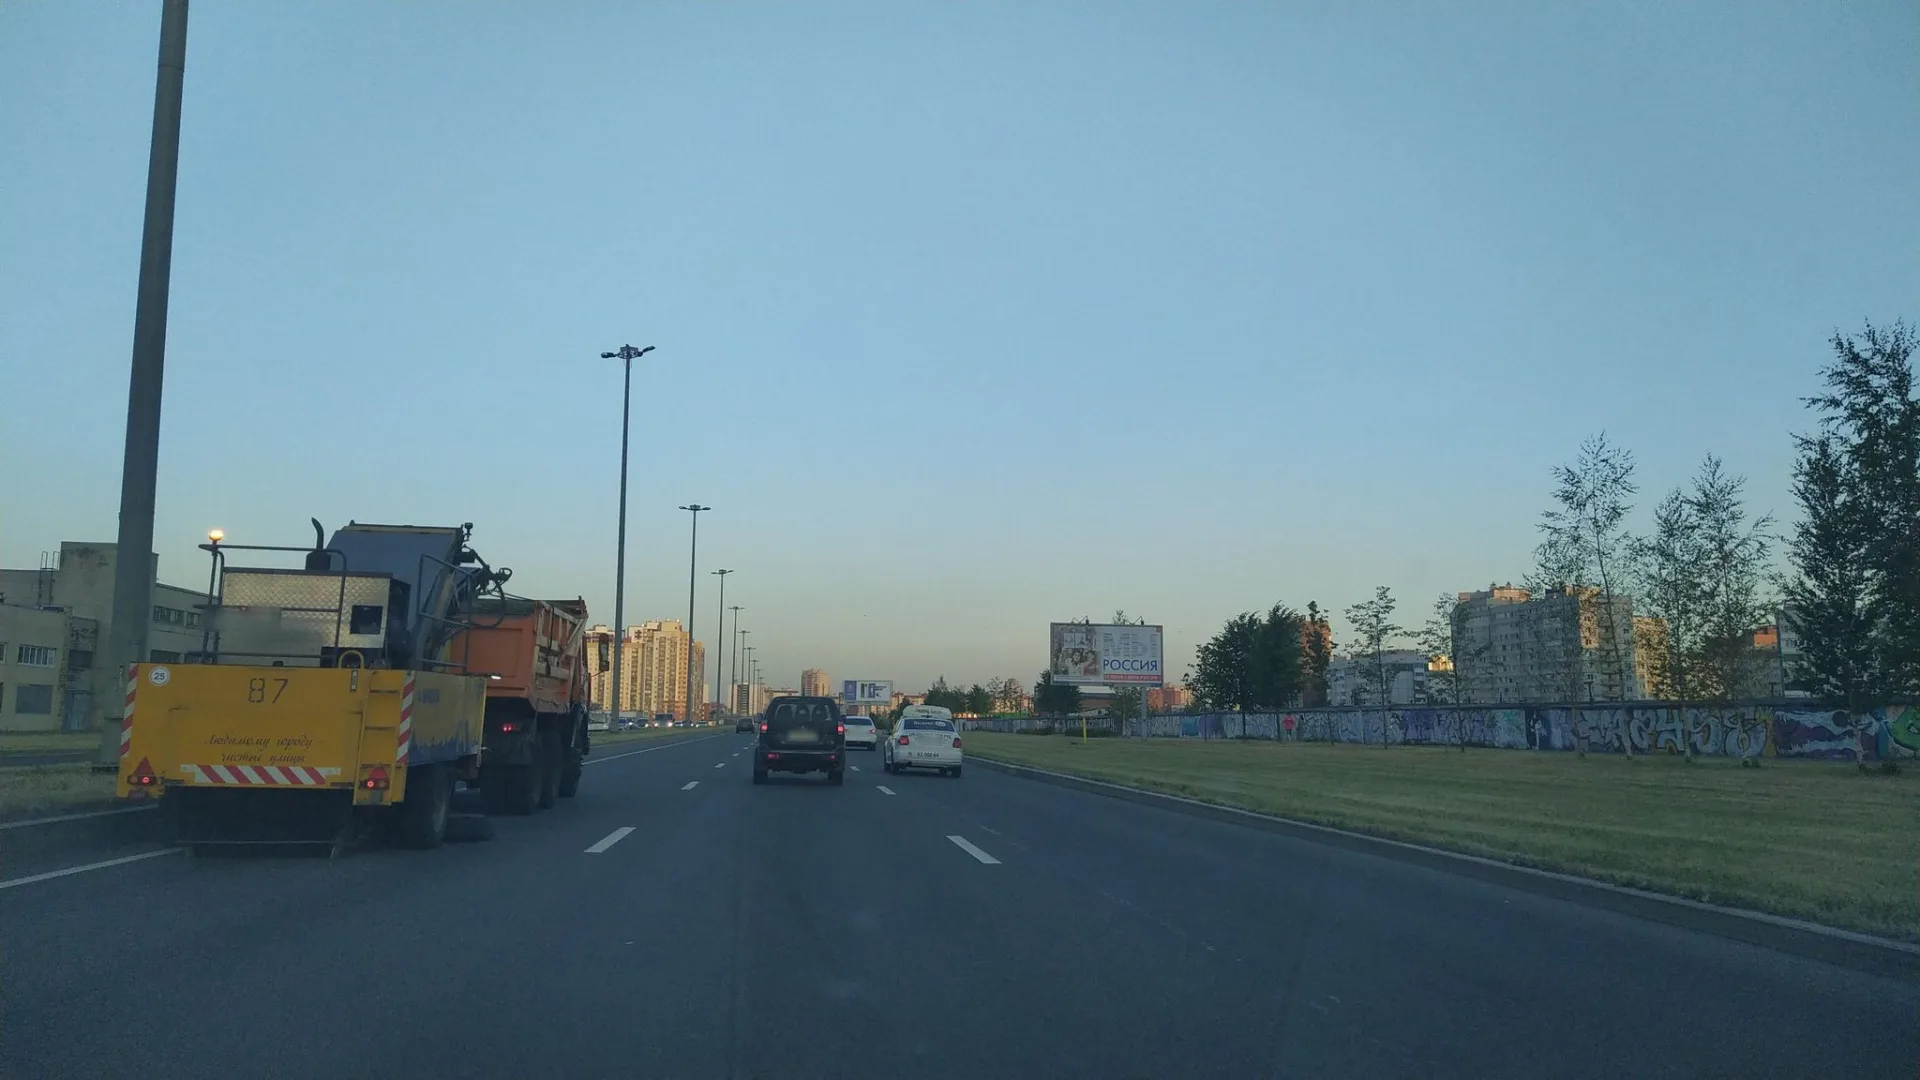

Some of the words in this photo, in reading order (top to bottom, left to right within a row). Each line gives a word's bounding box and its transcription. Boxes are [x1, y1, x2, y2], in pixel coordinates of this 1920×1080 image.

[1103, 659, 1158, 671] РОССИЯ
[153, 672, 166, 681] 25
[248, 678, 288, 703] 87
